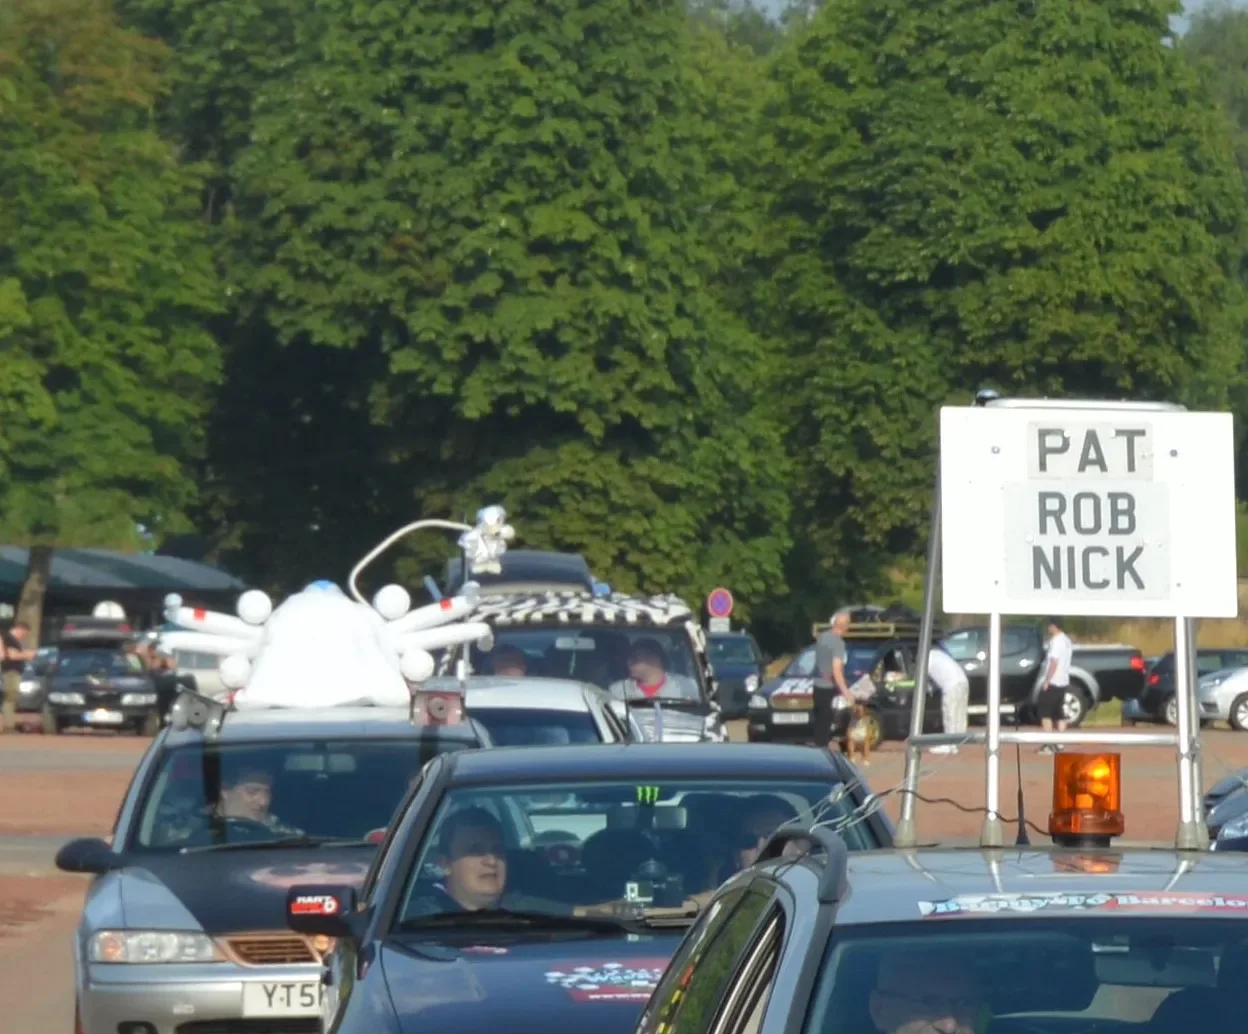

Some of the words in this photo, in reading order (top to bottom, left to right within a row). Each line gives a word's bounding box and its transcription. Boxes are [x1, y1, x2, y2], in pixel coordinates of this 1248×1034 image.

[1037, 428, 1146, 472] PAT
[1037, 491, 1136, 535] ROB
[1032, 545, 1145, 590] NICK
[262, 983, 324, 1008] YT5
